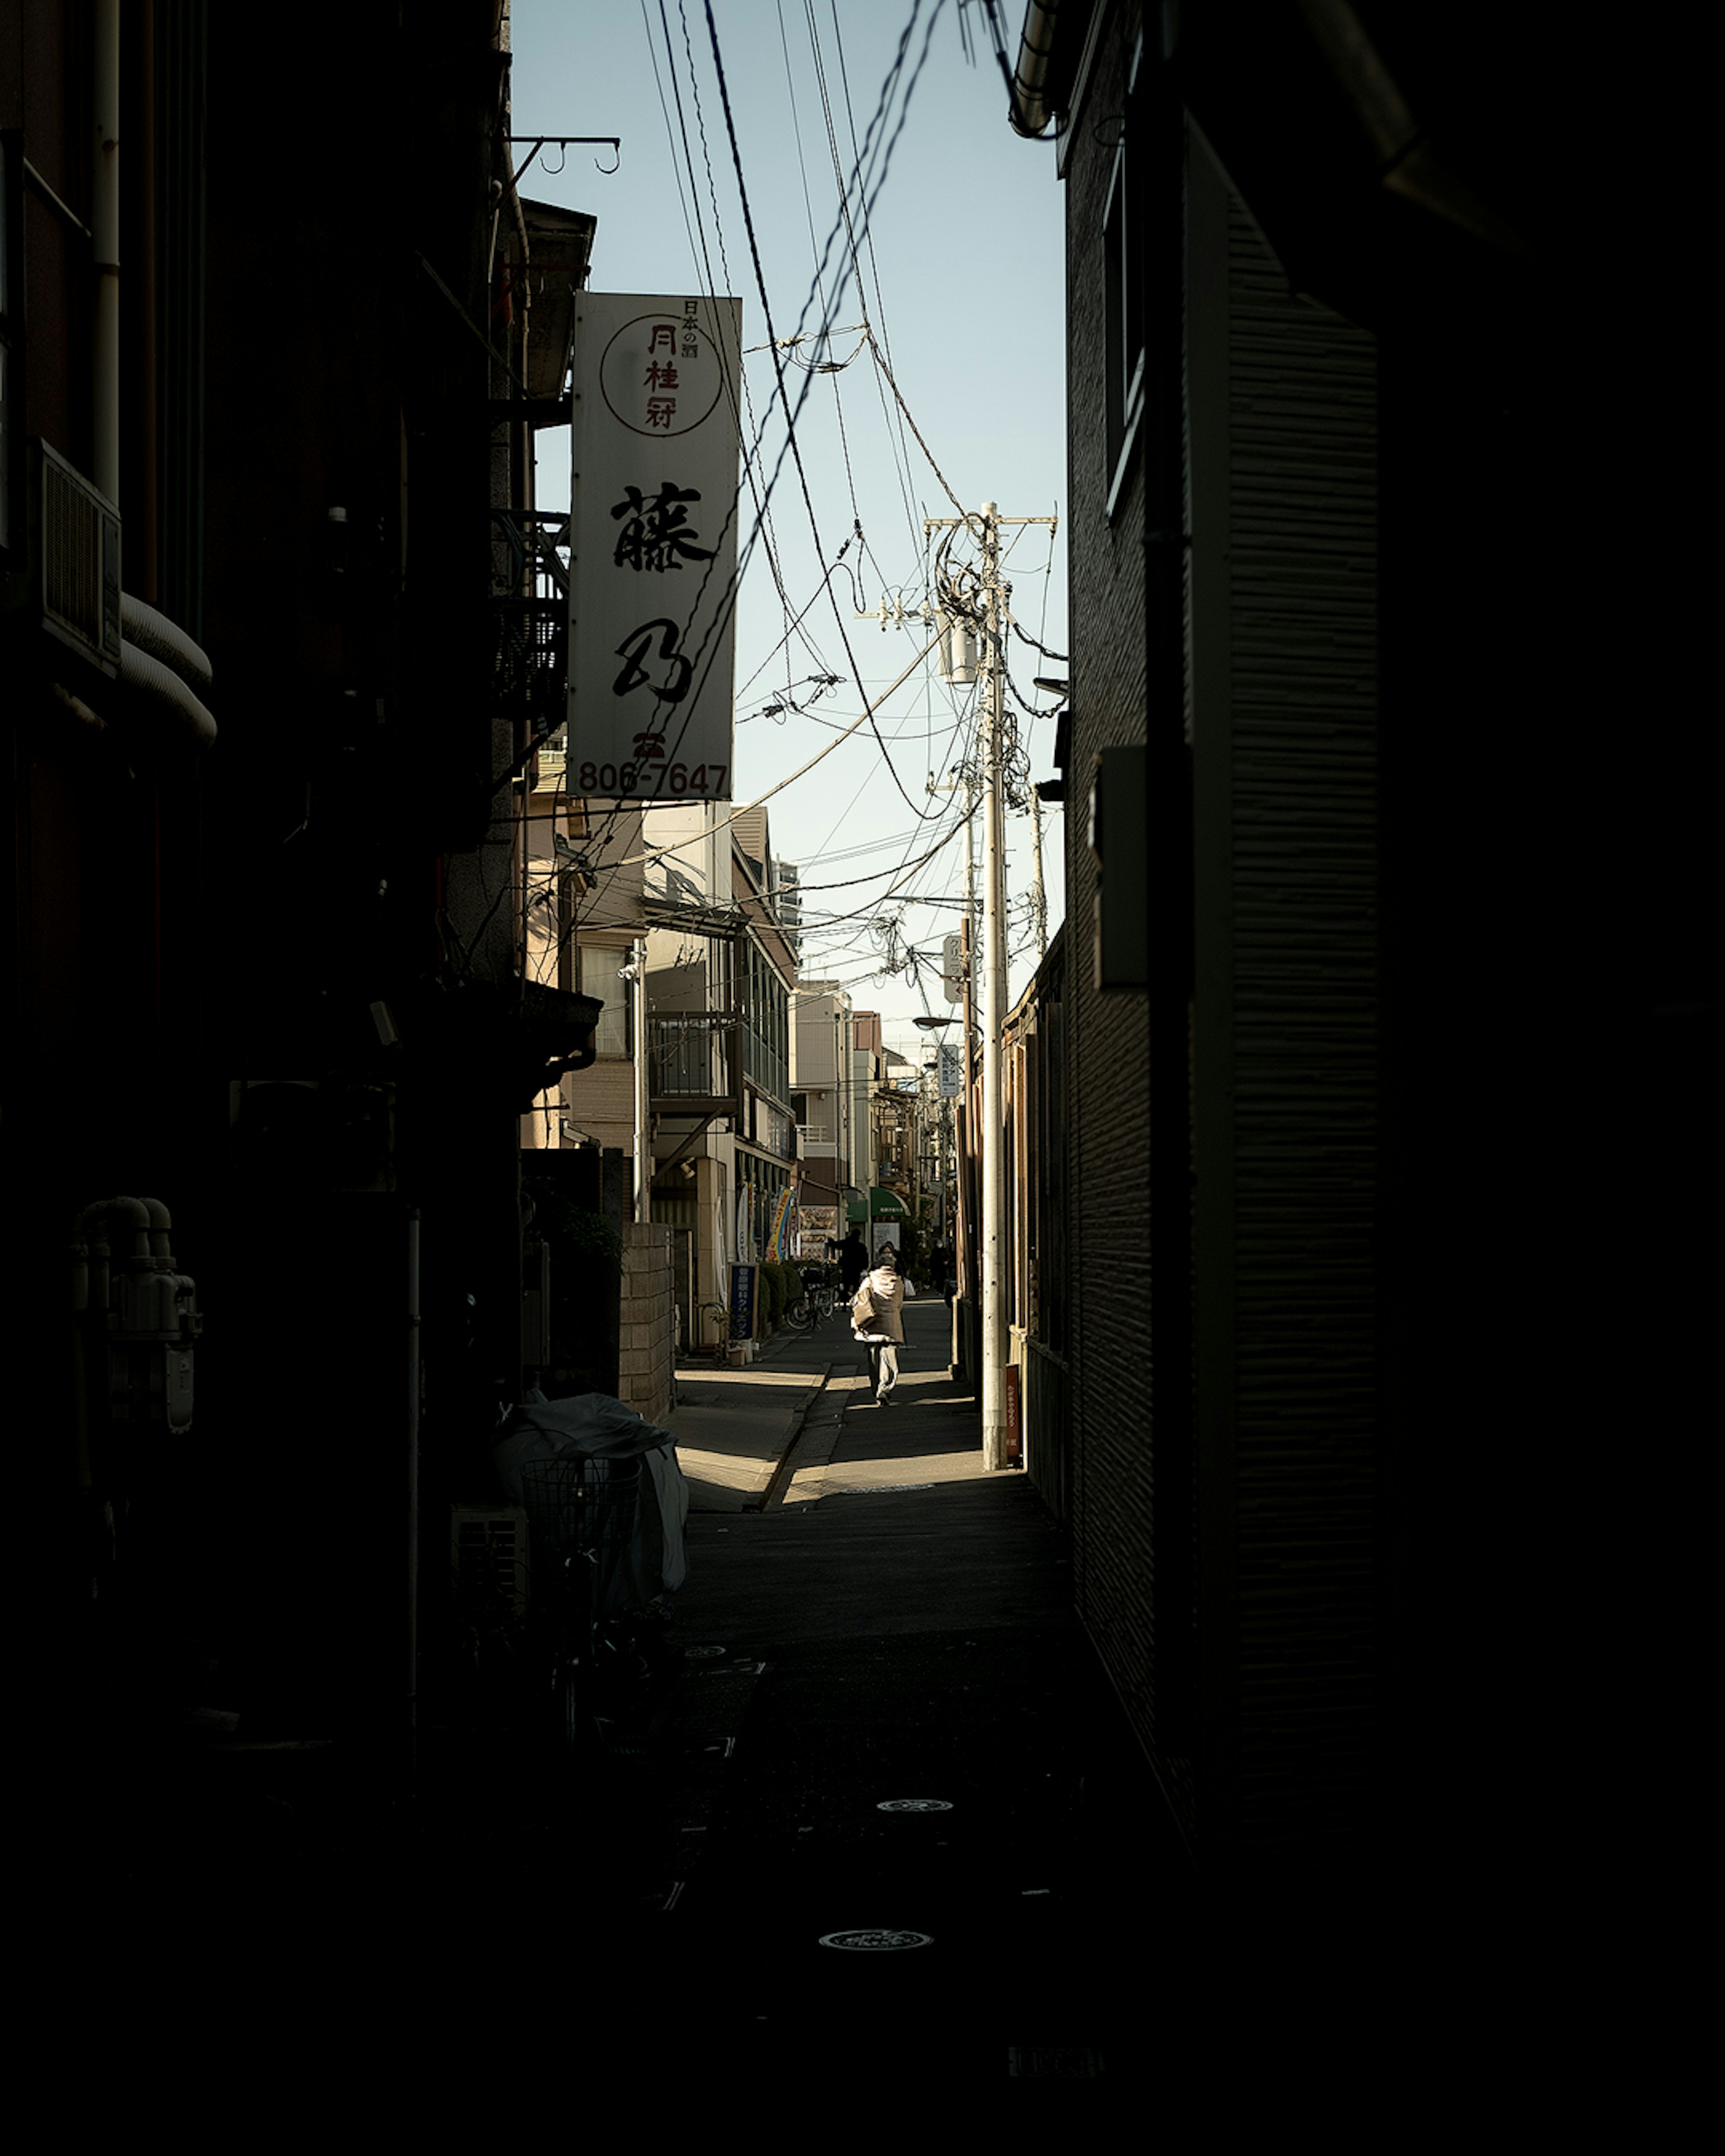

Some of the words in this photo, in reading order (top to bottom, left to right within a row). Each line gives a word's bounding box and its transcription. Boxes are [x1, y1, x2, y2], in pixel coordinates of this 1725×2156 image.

[682, 300, 699, 358] 日本の酒
[644, 324, 679, 429] 月桂冠
[579, 762, 727, 794] 806-7647
